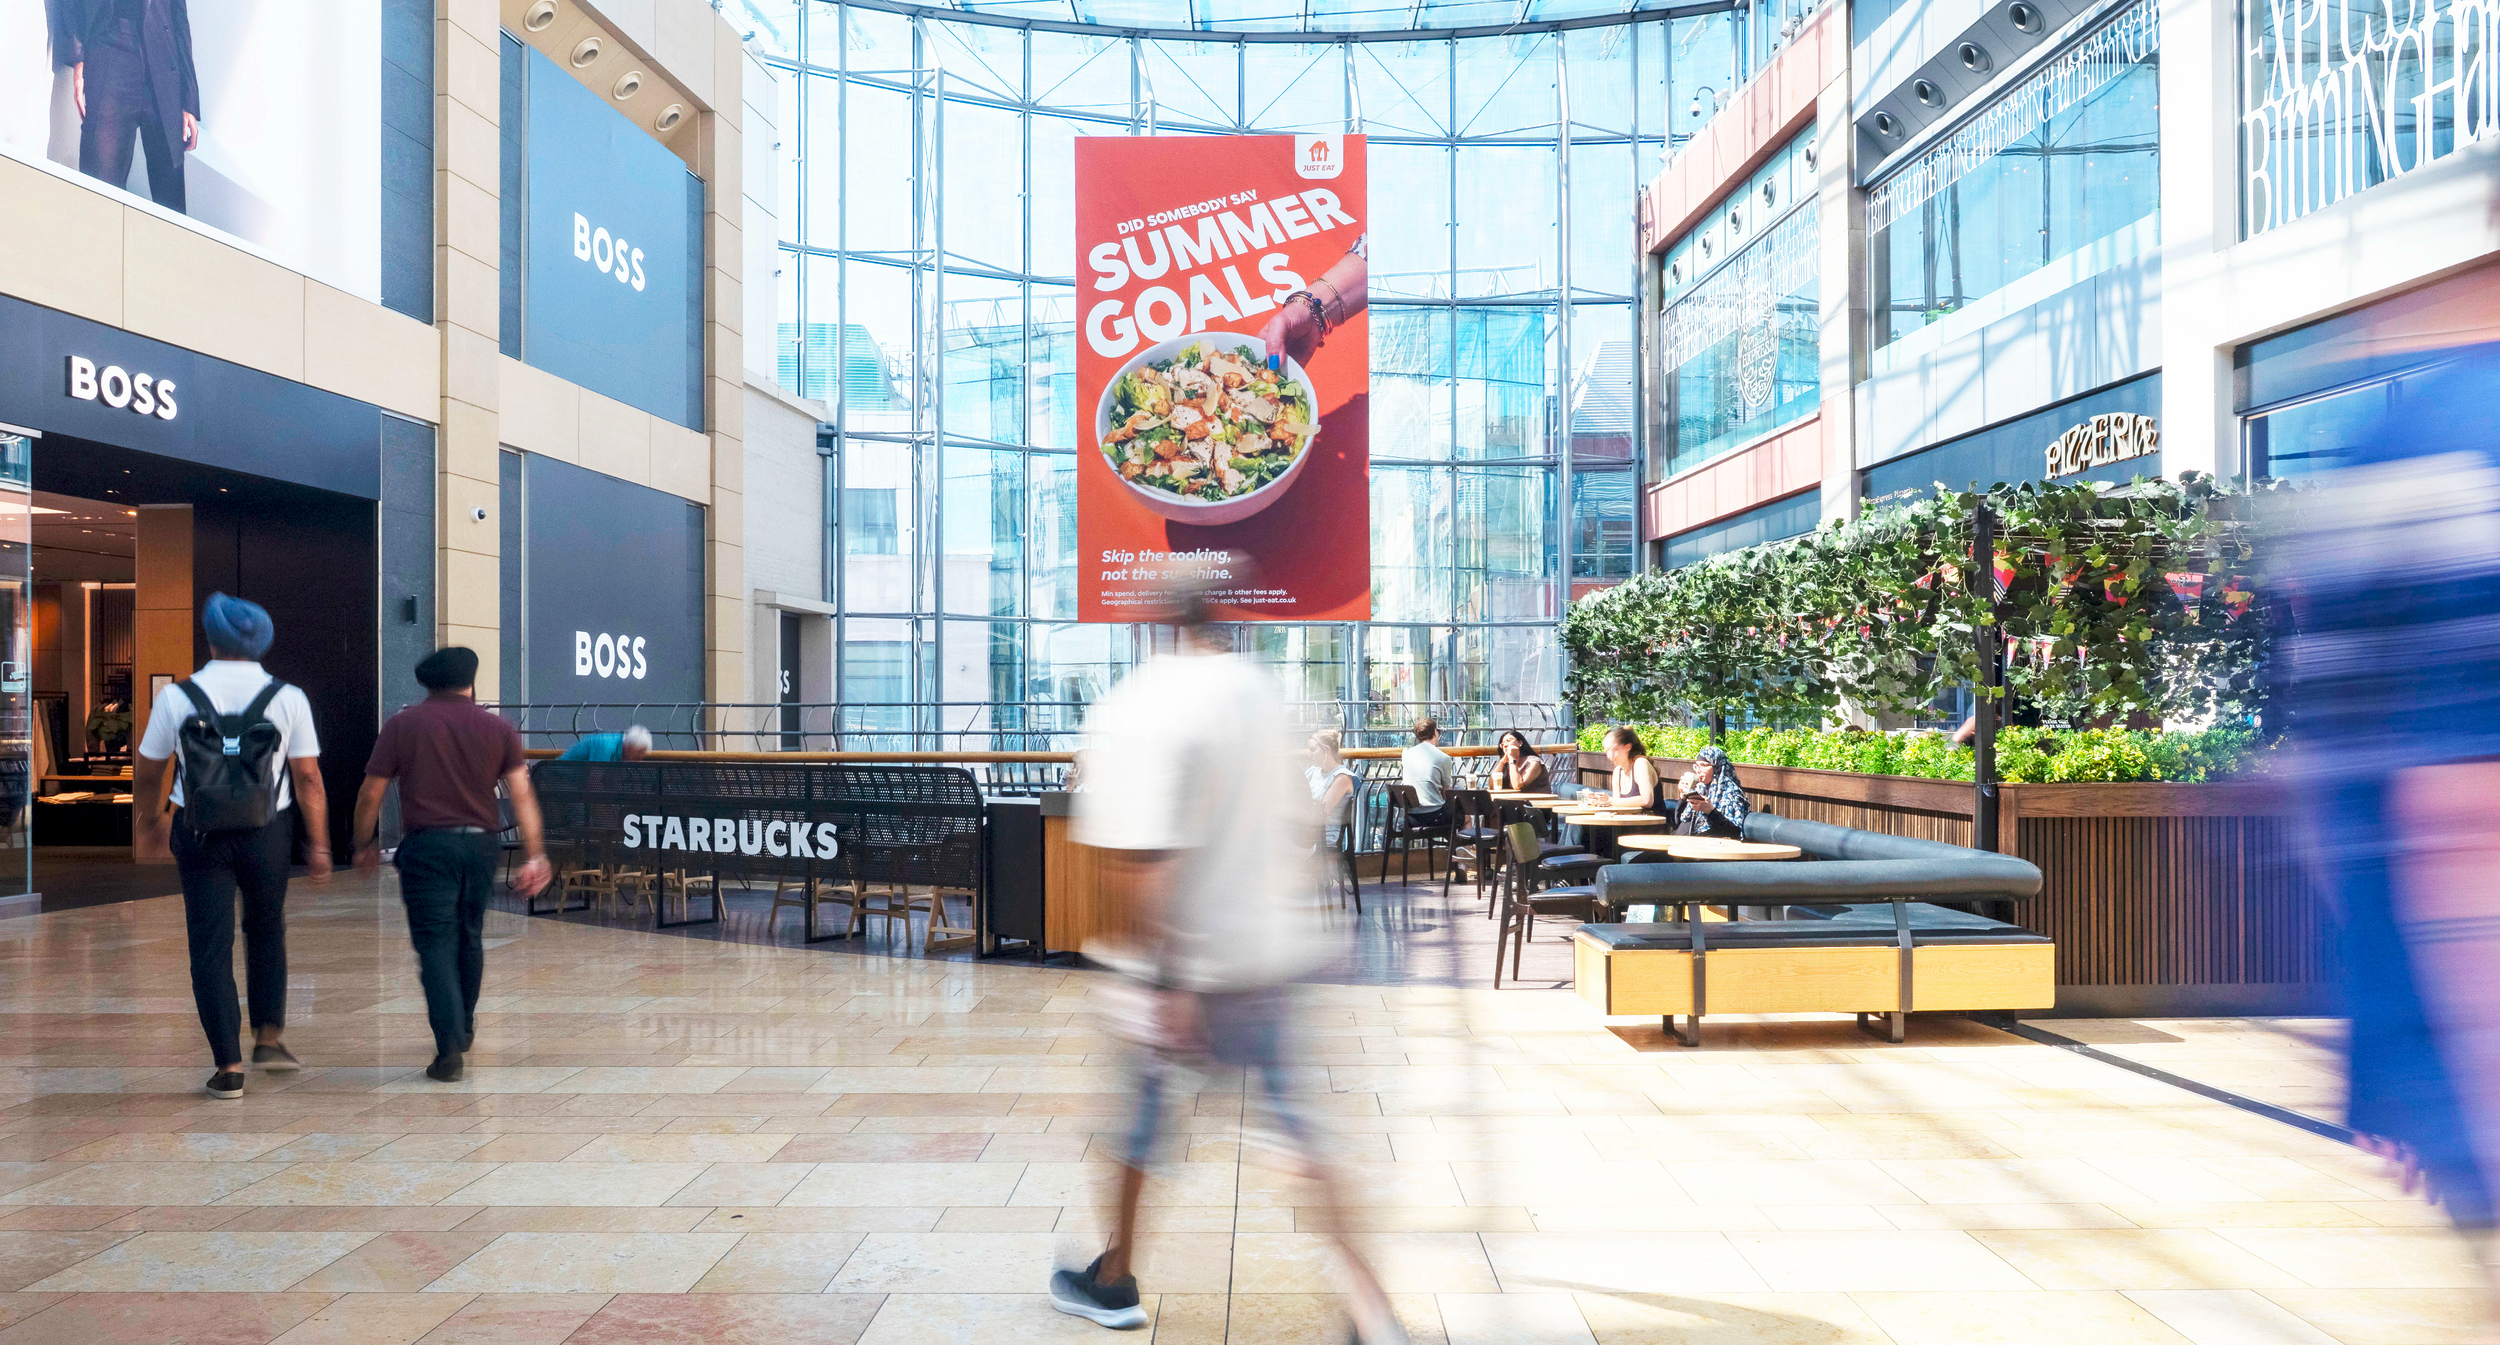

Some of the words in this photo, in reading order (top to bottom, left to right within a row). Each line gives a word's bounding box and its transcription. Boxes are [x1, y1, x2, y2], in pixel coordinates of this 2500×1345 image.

[1302, 164, 1320, 172] JUST
[1117, 219, 1145, 235] DID
[1147, 196, 1229, 227] SOMEBODY
[1229, 189, 1259, 206] SAY
[572, 211, 646, 292] BOSS
[1088, 187, 1357, 292] SUMMER
[1085, 252, 1308, 358] GOALS
[1742, 338, 1775, 368] EXPRESS
[66, 354, 178, 420] BOSS
[2044, 411, 2158, 480] PIZZERIA
[1101, 549, 1135, 565] Skip
[1138, 549, 1164, 562] the
[1168, 548, 1232, 564] cooking,
[1101, 568, 1128, 581] not
[1132, 567, 1158, 580] the
[1161, 566, 1233, 580] sushine.
[1101, 599, 1143, 607] Geographical
[1253, 596, 1297, 605] just-eat.co.uk
[1138, 590, 1163, 598] delivery
[1268, 588, 1288, 596] apply.
[575, 630, 647, 680] BOSS
[623, 813, 839, 860] STARBUCKS
